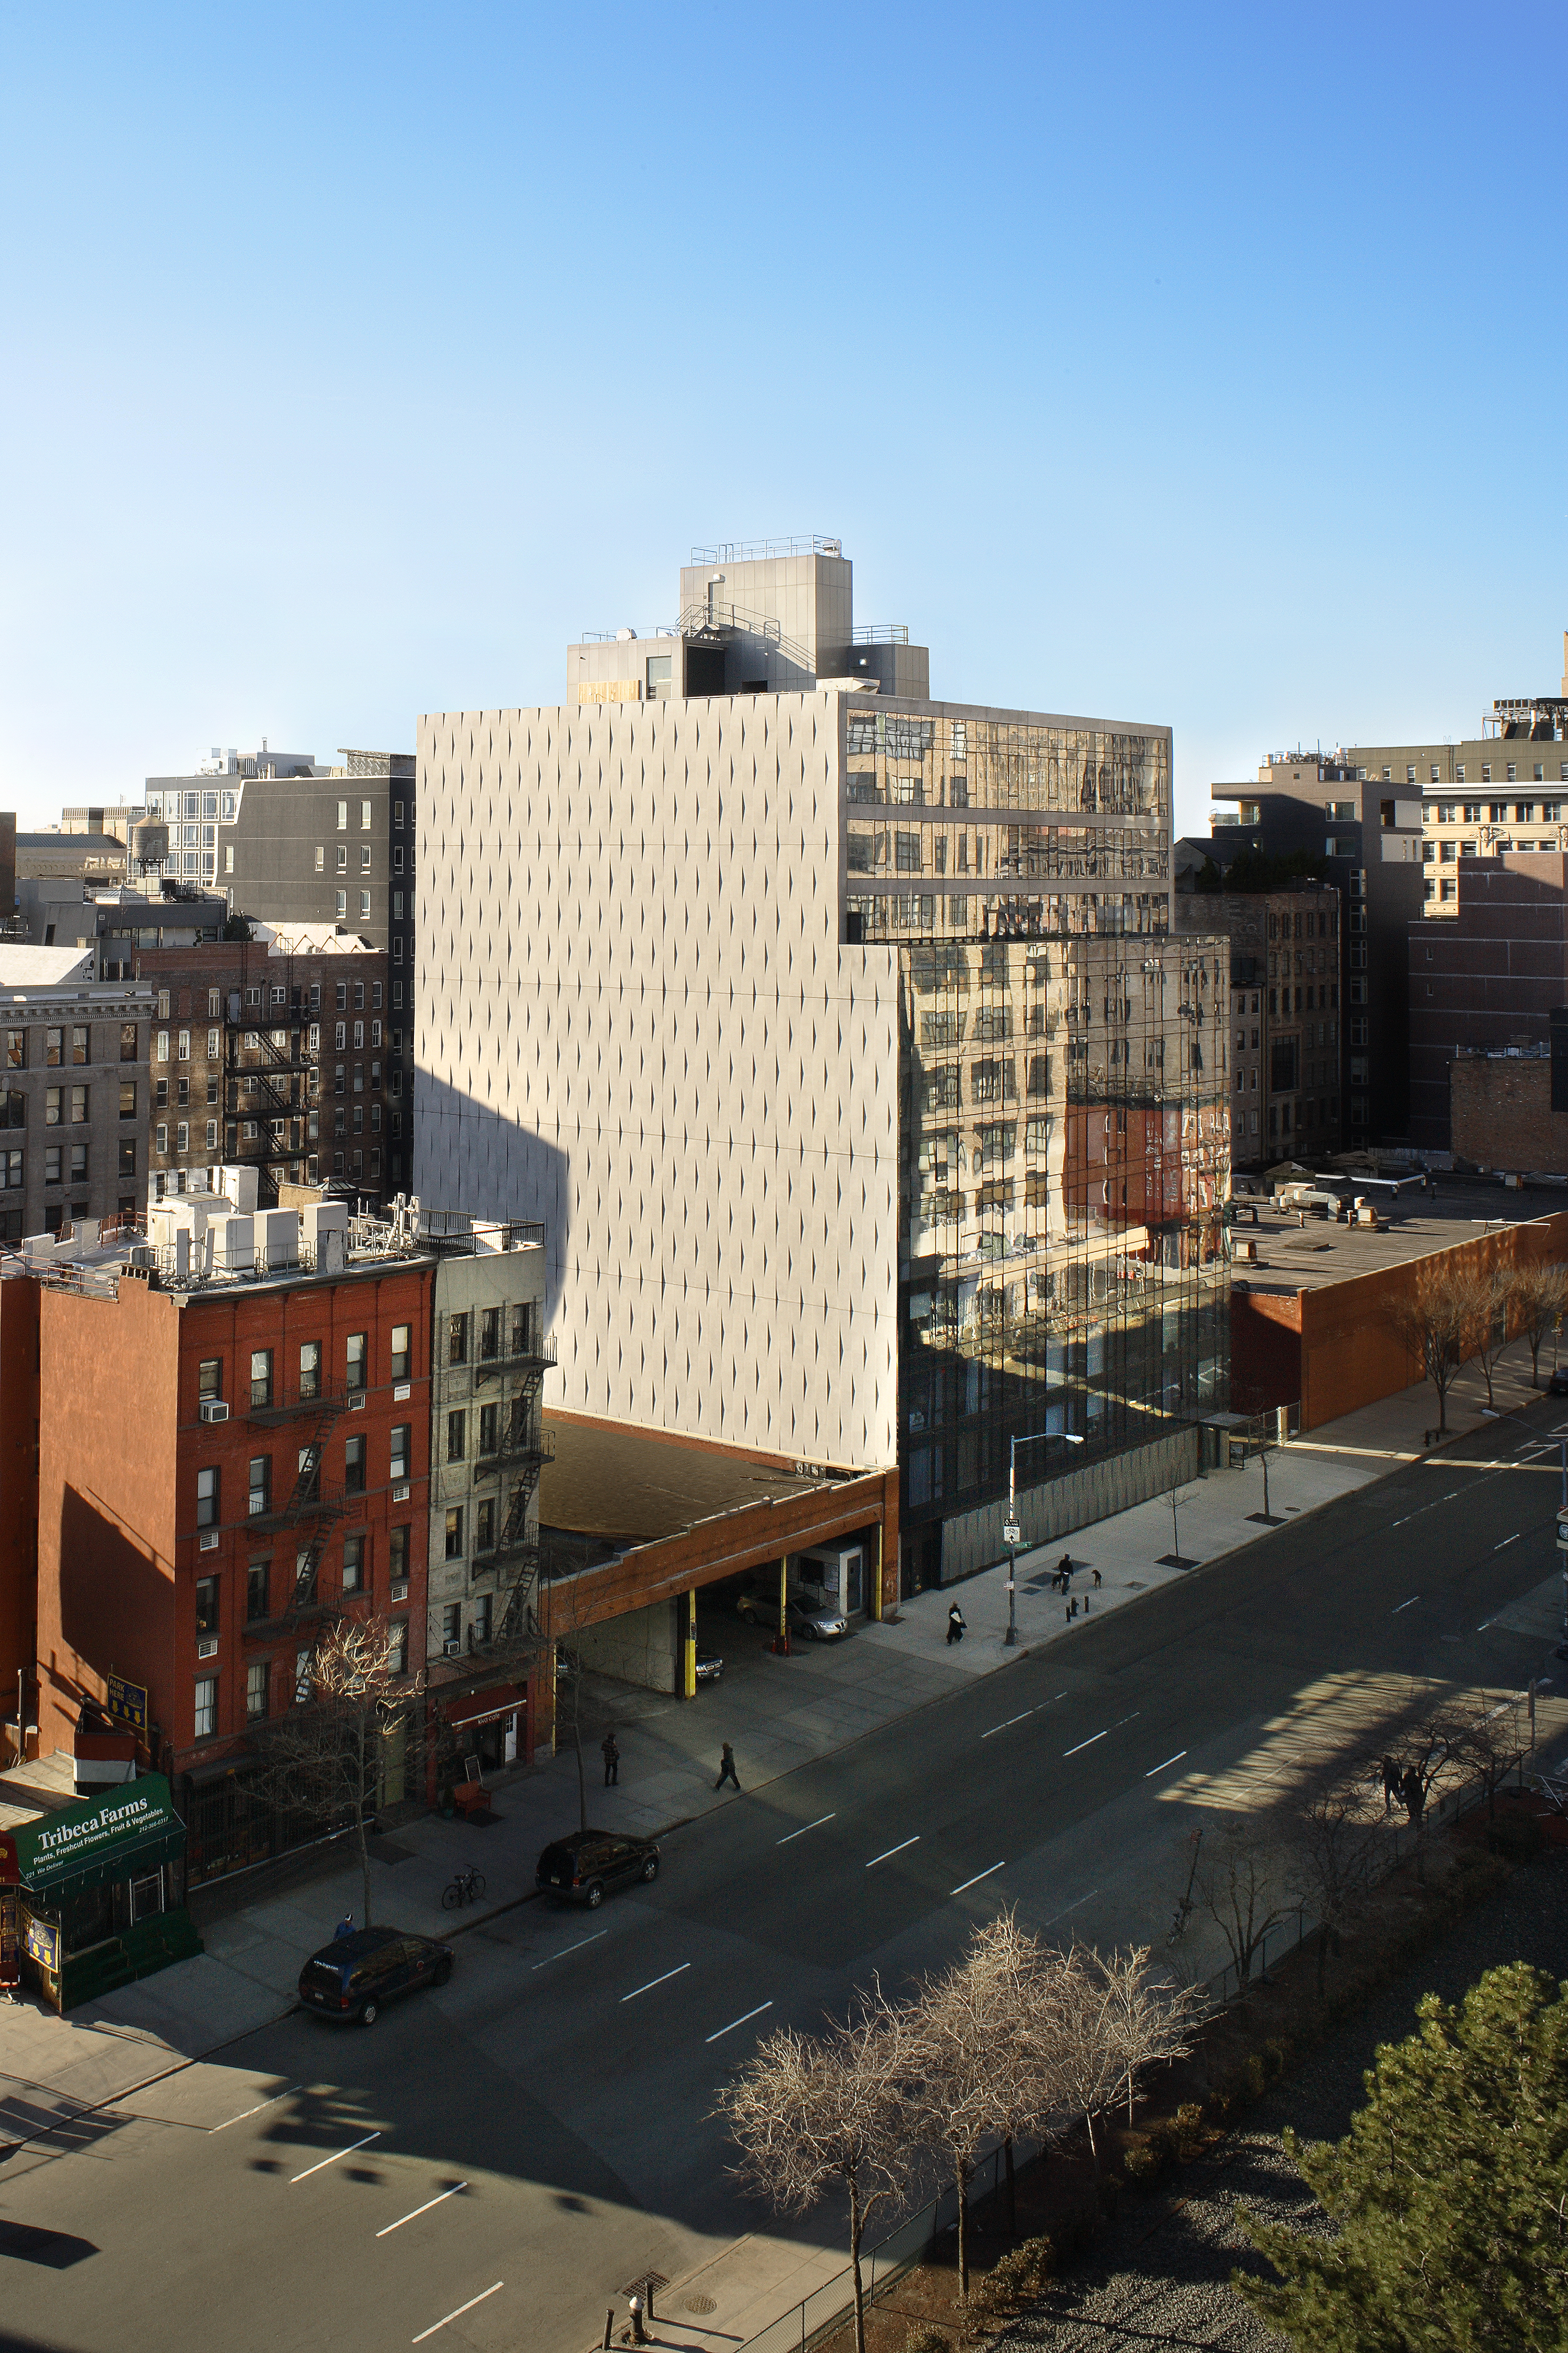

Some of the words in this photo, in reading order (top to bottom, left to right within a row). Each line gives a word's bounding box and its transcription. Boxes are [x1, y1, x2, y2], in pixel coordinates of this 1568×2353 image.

[110, 1679, 125, 1692] PARK
[110, 1688, 124, 1701] HERE
[38, 1818, 99, 1850] Tribeca
[100, 1797, 148, 1826] Farms
[33, 1852, 55, 1865] Plants,
[56, 1840, 84, 1856] Freshcut
[84, 1830, 110, 1845] Flowers,
[111, 1823, 125, 1834] Fruit
[125, 1820, 131, 1828] &
[131, 1808, 164, 1825] Vegetables
[46, 1860, 64, 1871] Deliver
